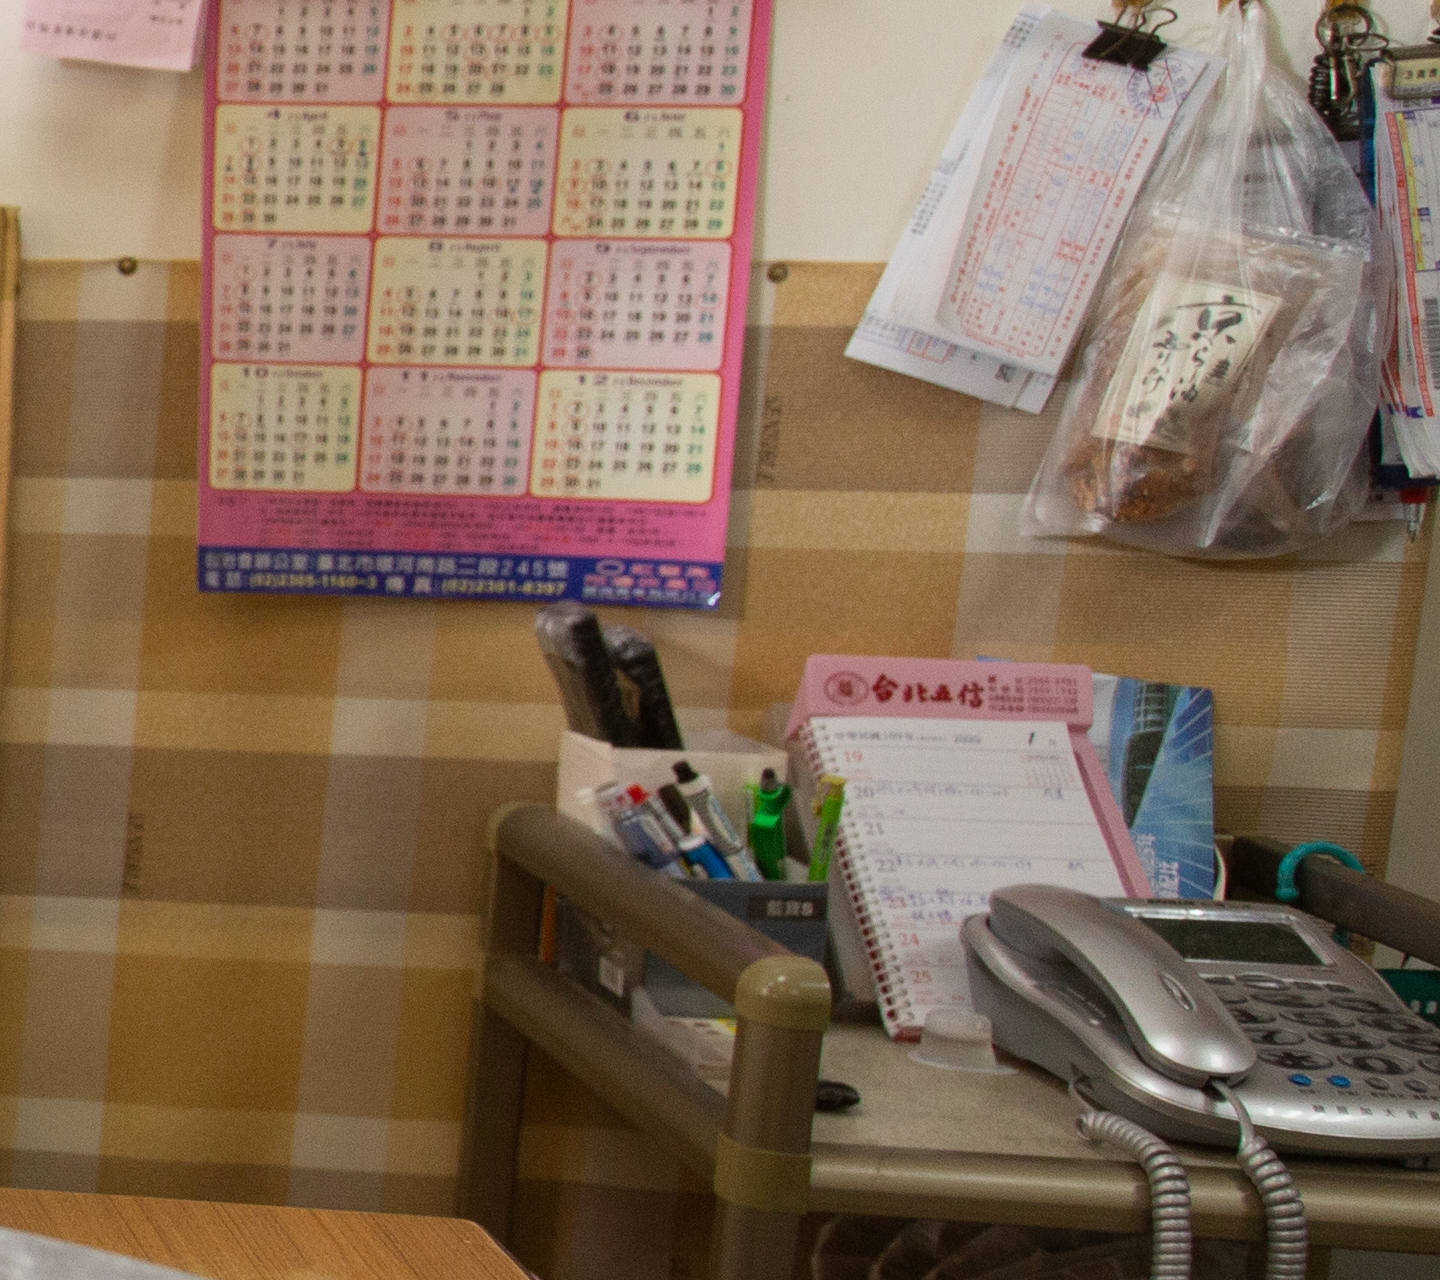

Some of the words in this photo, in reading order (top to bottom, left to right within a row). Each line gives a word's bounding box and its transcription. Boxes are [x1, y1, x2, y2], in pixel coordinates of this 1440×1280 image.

[843, 750, 864, 762] 19
[853, 785, 874, 799] 20
[864, 823, 883, 835] 21
[876, 859, 896, 872] 22
[899, 933, 919, 946] 24
[911, 970, 932, 984] 25
